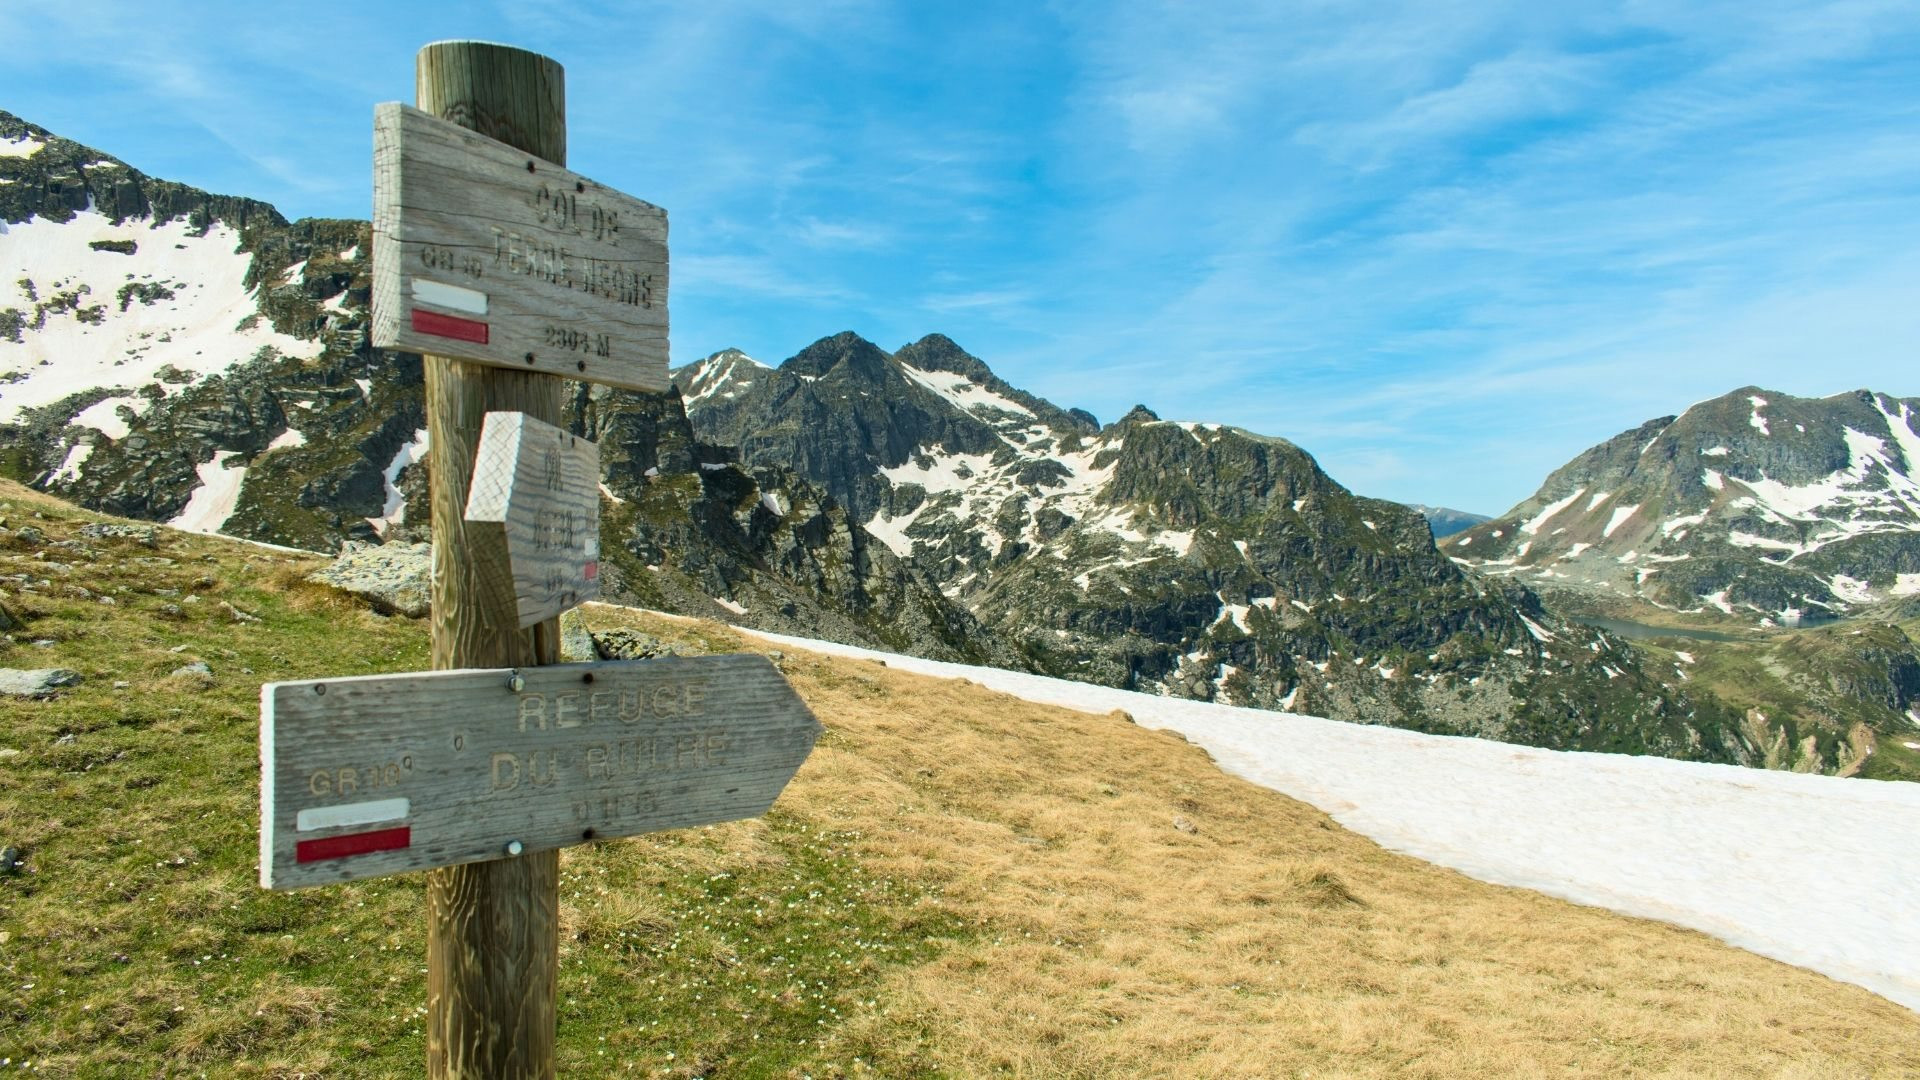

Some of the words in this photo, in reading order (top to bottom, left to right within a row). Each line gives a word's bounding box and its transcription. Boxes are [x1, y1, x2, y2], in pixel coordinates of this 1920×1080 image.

[536, 186, 581, 236] COL
[591, 204, 618, 247] DE
[421, 246, 454, 272] GR
[491, 226, 573, 289] TERRE
[518, 680, 706, 733] REFUGE
[308, 767, 357, 797] GR
[489, 746, 558, 793] DU
